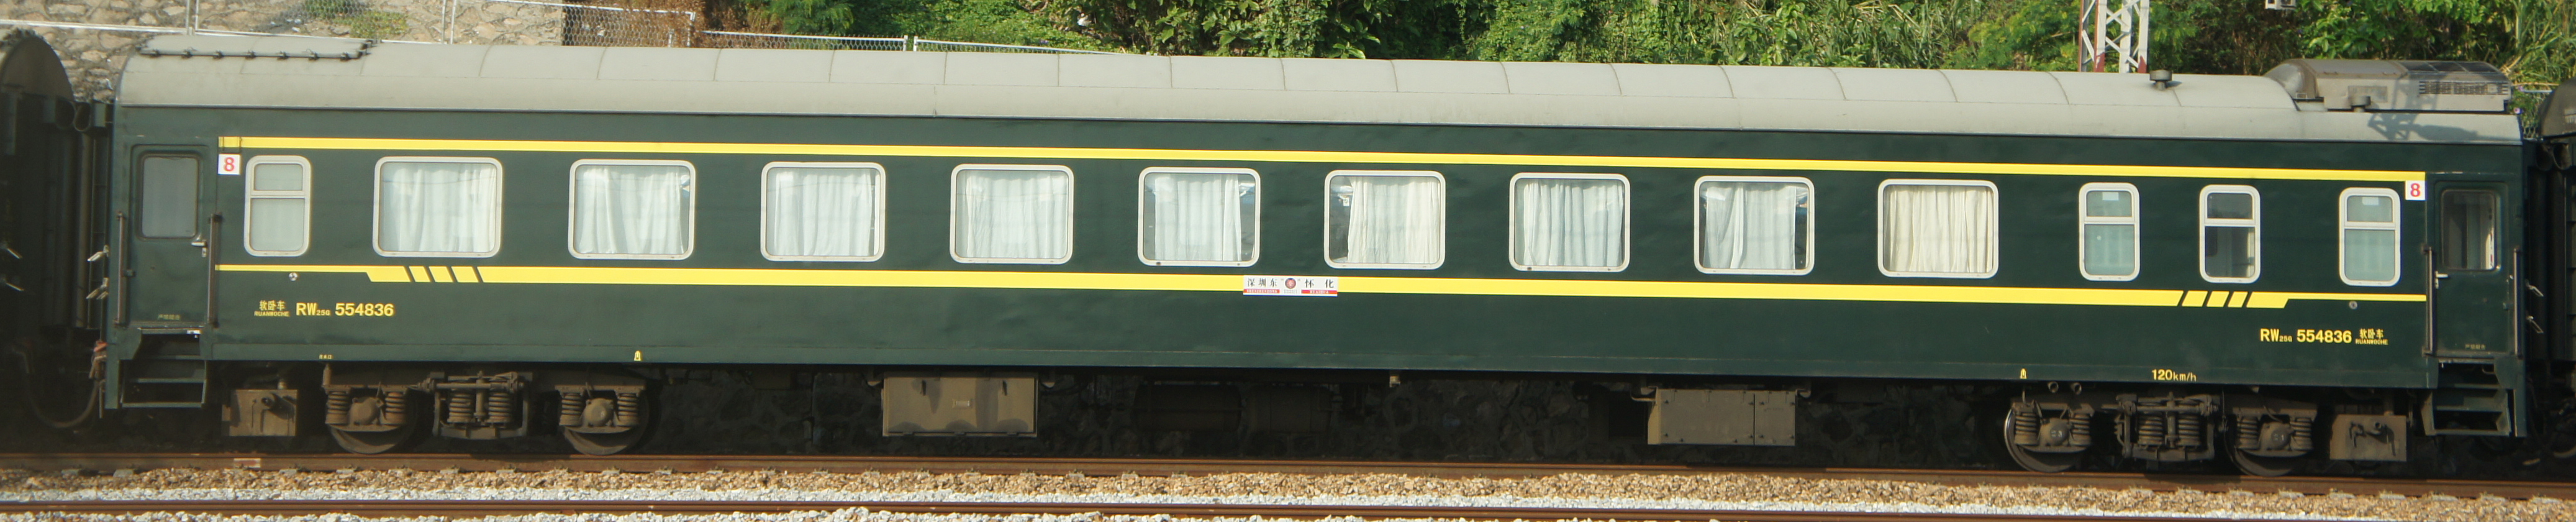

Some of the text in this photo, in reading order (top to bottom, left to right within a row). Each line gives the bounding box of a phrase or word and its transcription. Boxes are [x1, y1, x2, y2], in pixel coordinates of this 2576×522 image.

[224, 157, 235, 172] 8
[2410, 183, 2421, 197] 8
[1248, 278, 1334, 288] 深圳东 怀化
[259, 300, 286, 311] 软卧车
[335, 303, 394, 316] 554836
[2297, 329, 2352, 343] 554836
[2359, 328, 2384, 339] 软卧车
[2151, 369, 2197, 382] 120km/h
